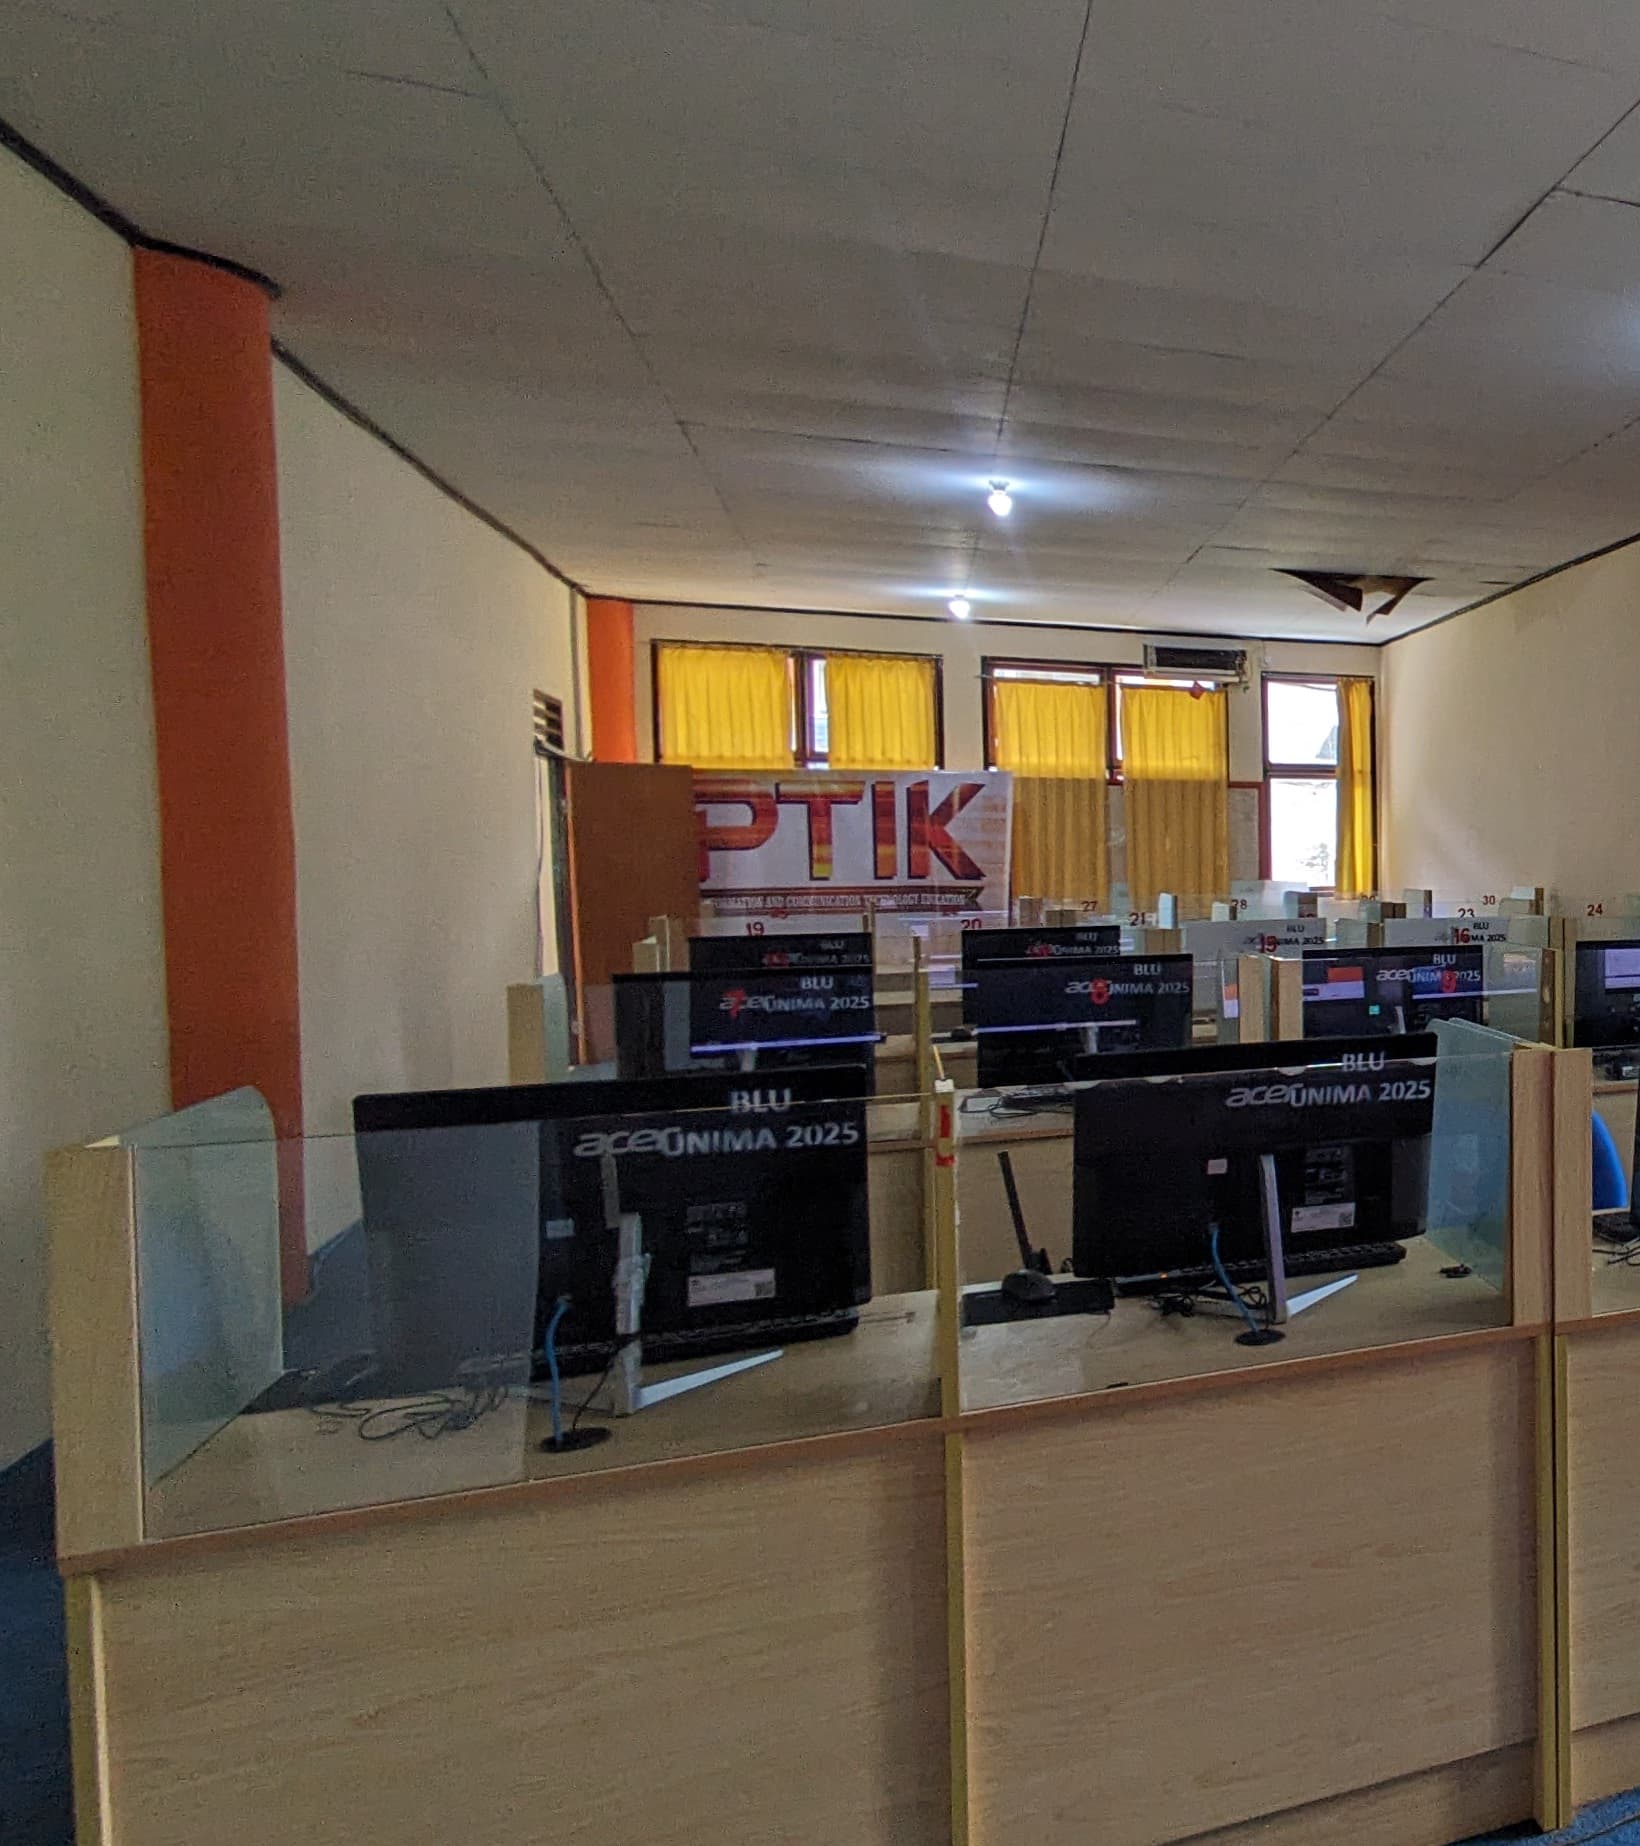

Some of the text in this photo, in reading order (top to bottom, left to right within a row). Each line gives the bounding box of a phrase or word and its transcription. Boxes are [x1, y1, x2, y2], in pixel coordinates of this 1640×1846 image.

[692, 778, 987, 881] PTIK
[1482, 895, 1496, 906] 30
[1586, 903, 1604, 917] 24
[745, 920, 765, 937] 19
[1453, 928, 1471, 944] 16
[1432, 953, 1457, 965] BLU
[1133, 962, 1161, 976] BLU
[801, 975, 834, 990] BLU
[1157, 981, 1191, 994] 2025
[1441, 968, 1457, 993] 9
[830, 996, 870, 1010] 2025
[1341, 1051, 1386, 1073] BLU
[729, 1088, 793, 1114] BLU
[1290, 1079, 1432, 1109] UNIMA 2025
[661, 1121, 860, 1158] UNIMA 2025
